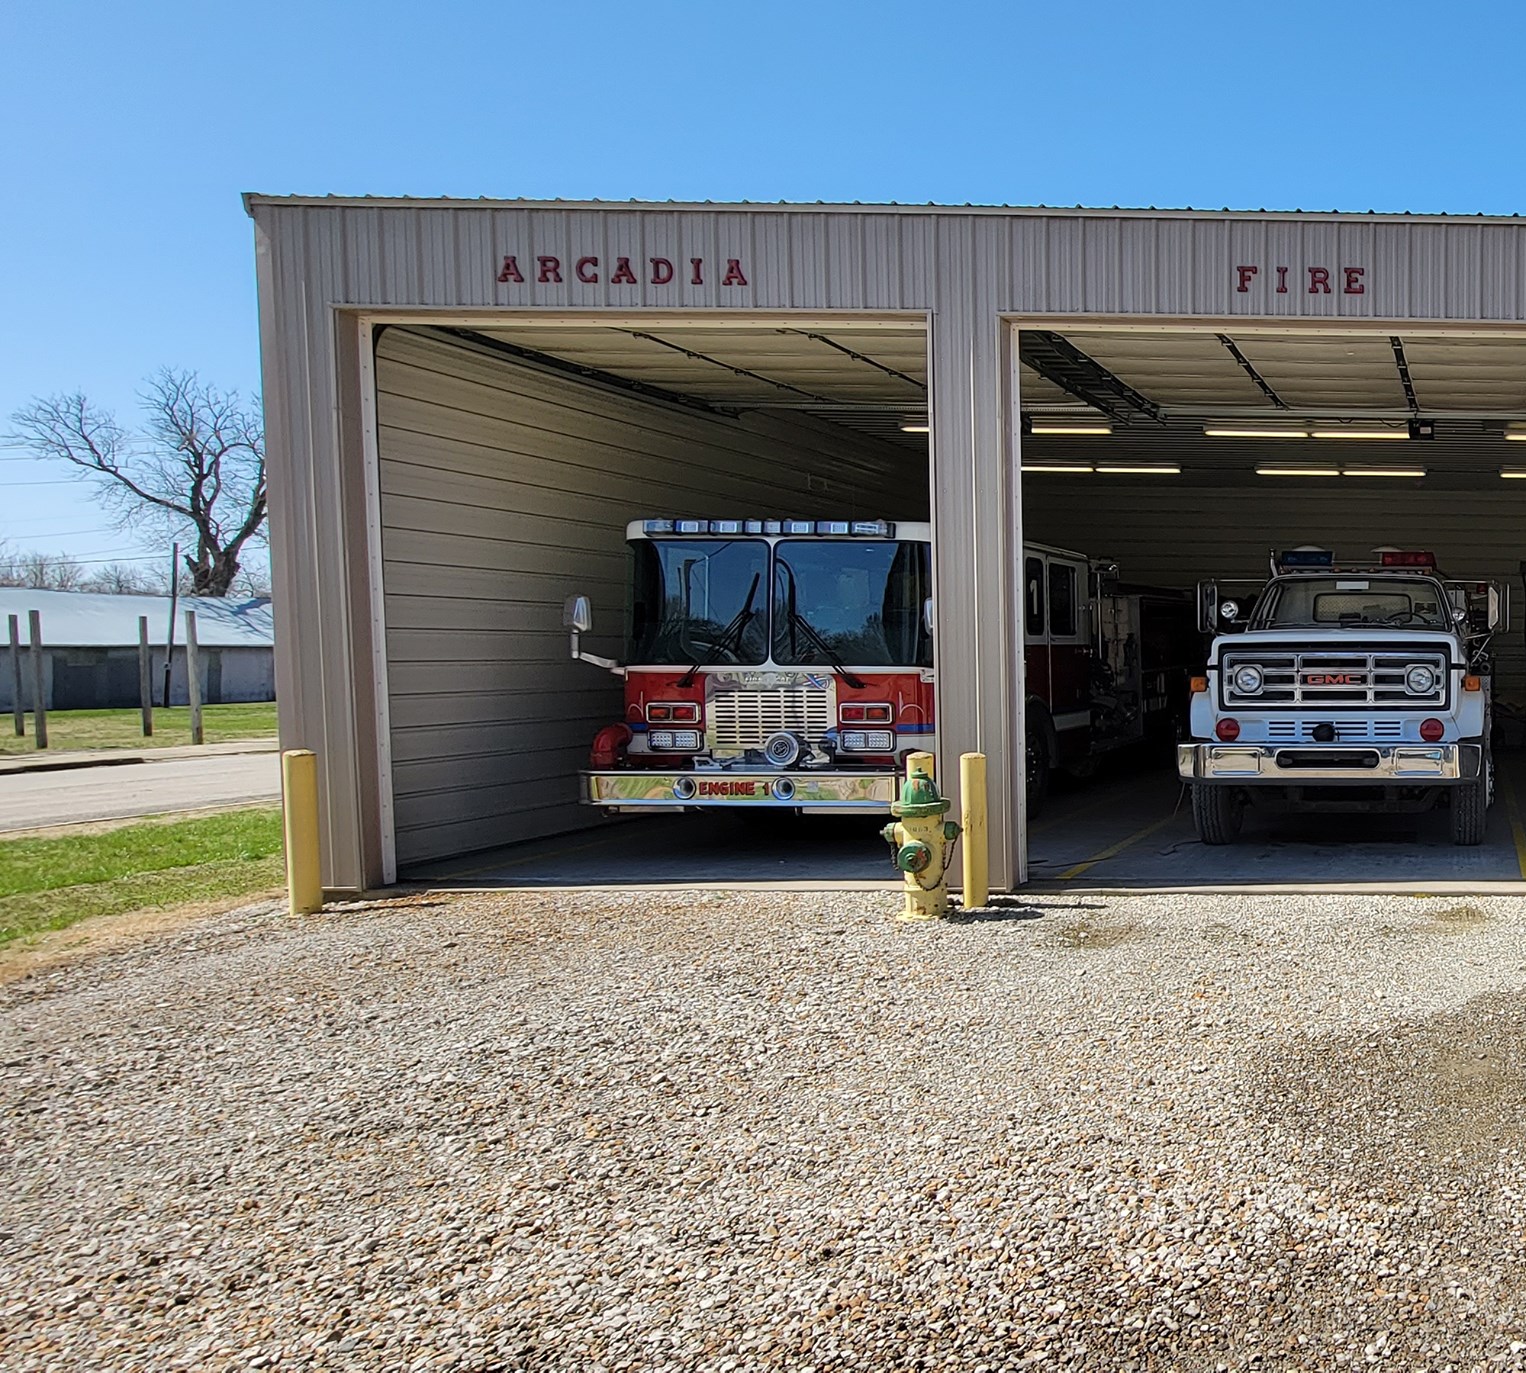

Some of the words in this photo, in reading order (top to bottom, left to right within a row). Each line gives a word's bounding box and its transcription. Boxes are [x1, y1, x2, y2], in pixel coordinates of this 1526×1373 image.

[497, 255, 748, 286] ARCADIA
[1236, 265, 1365, 294] FIRE
[1030, 579, 1038, 615] 1
[1307, 674, 1362, 685] GMC
[699, 782, 755, 796] ENGINE
[762, 782, 769, 796] 1
